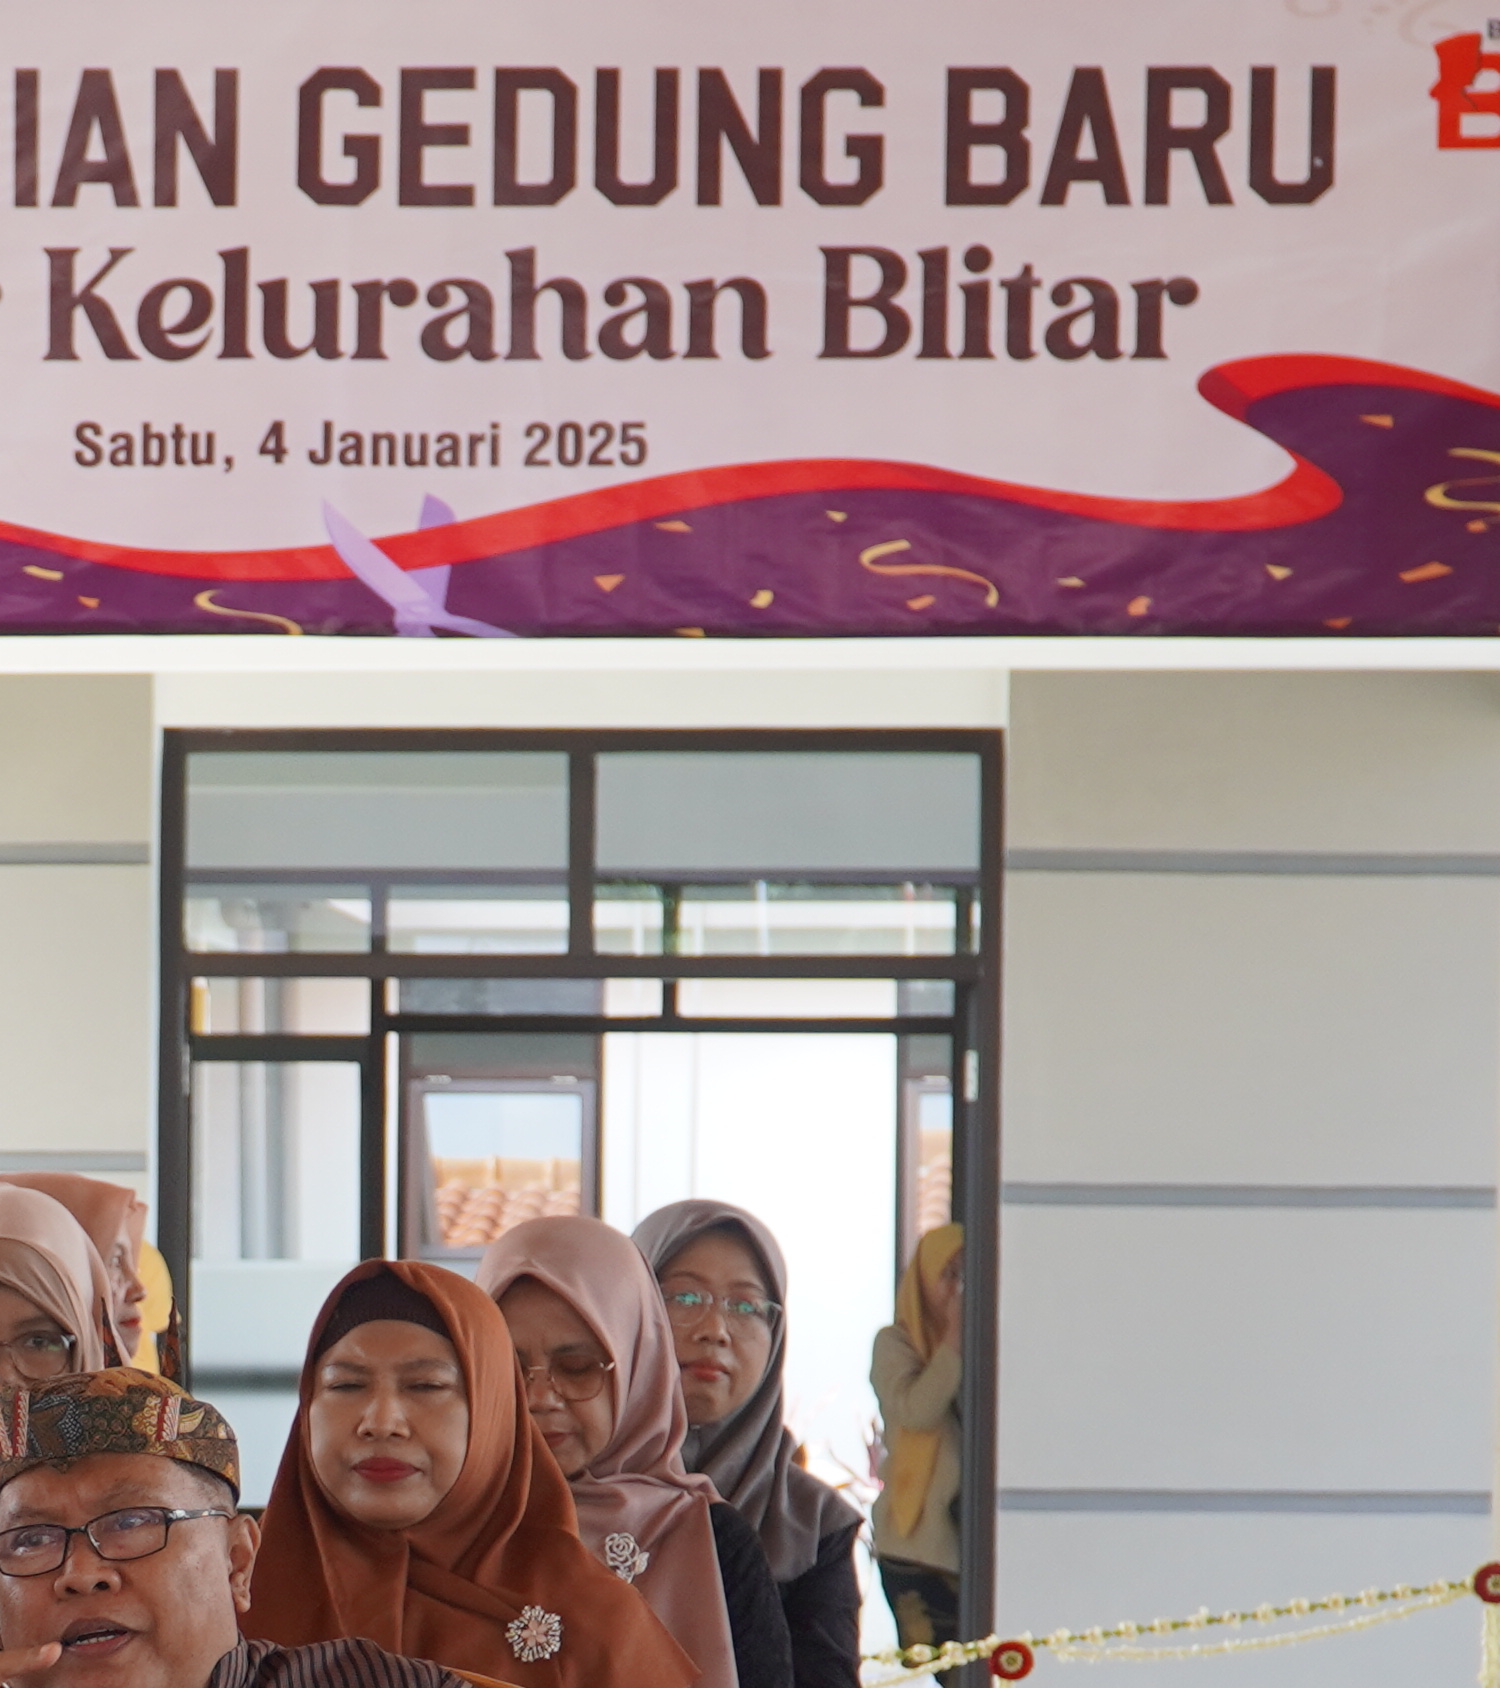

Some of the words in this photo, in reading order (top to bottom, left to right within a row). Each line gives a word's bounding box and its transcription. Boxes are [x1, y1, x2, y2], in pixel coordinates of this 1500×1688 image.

[298, 67, 885, 208] GEDUNG
[945, 65, 1337, 207] BARU
[45, 245, 771, 362] Kelurahan
[819, 243, 1199, 362] Blitar
[74, 421, 235, 472] Sabtu,
[258, 420, 288, 464] 4
[308, 420, 500, 467] Januari
[524, 421, 648, 467] 2025
